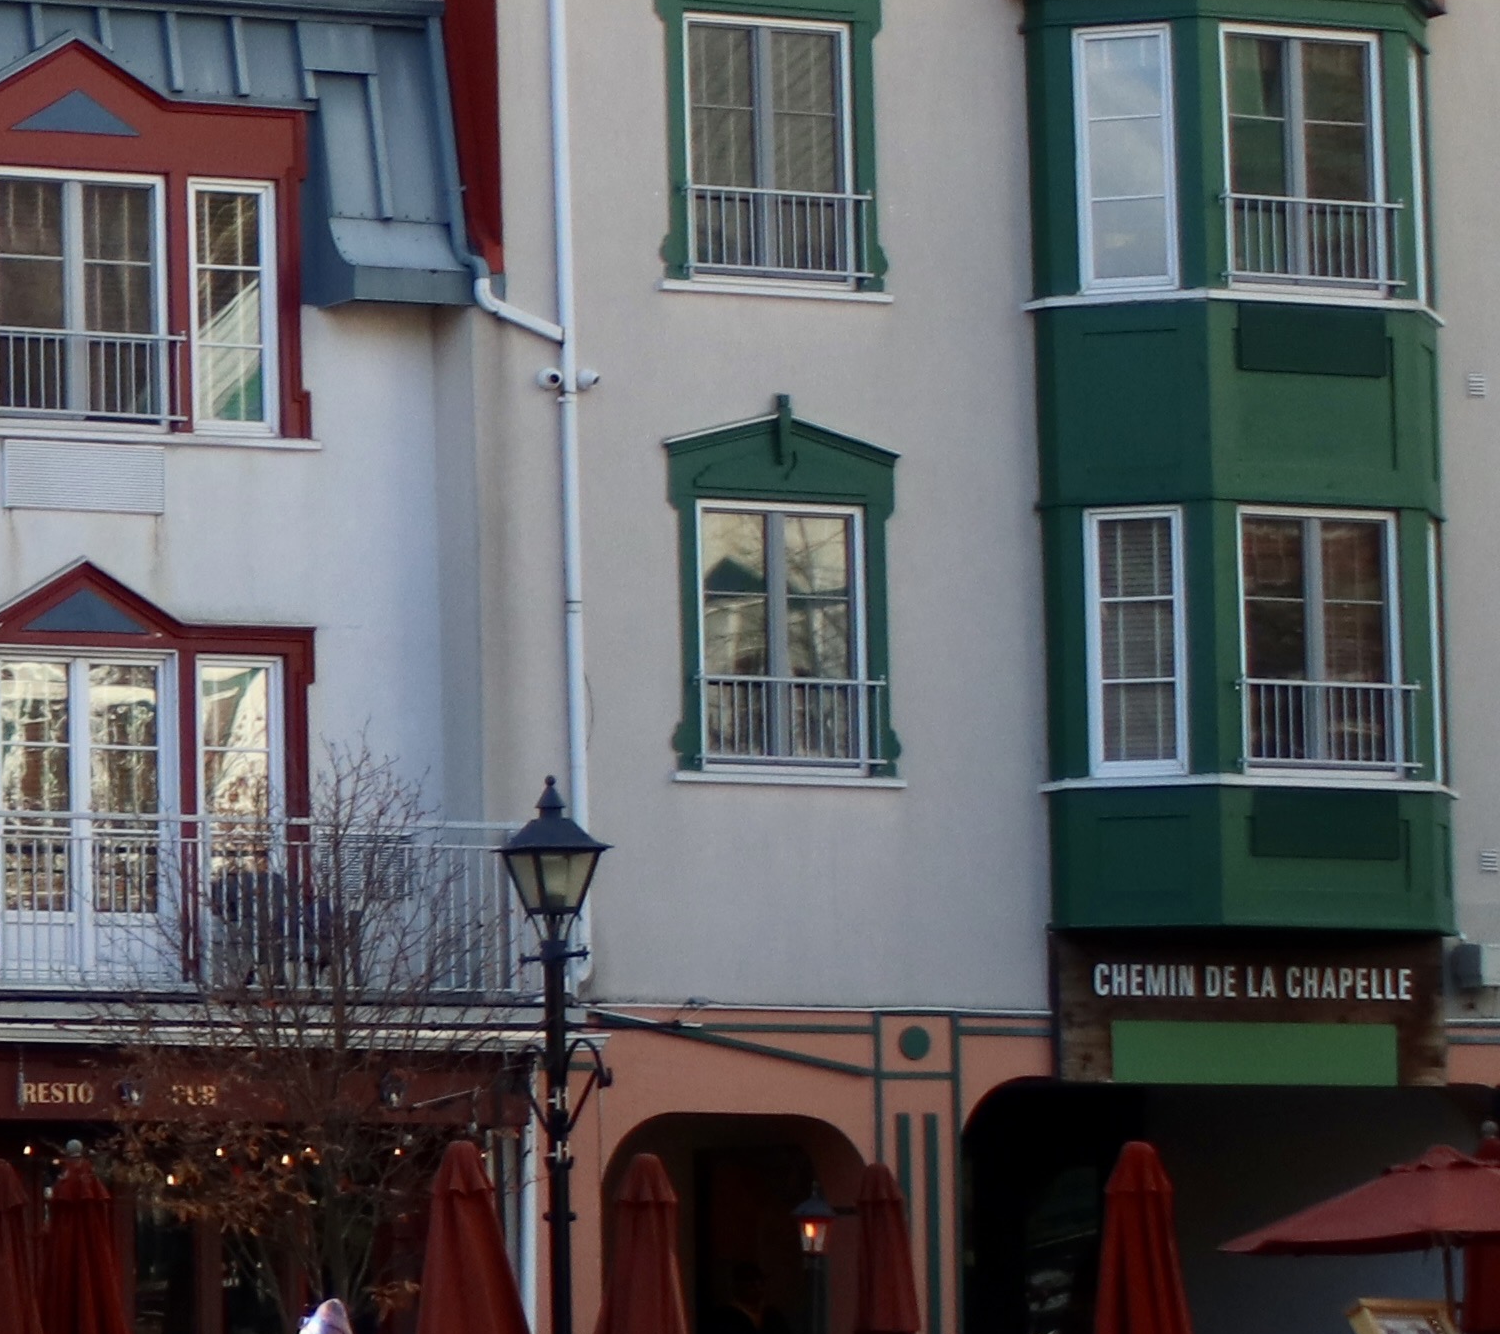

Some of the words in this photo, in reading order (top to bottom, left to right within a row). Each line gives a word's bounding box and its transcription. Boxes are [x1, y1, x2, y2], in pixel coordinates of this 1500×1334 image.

[1093, 963, 1195, 997] CHEMIN
[1205, 965, 1237, 998] DE
[1246, 966, 1277, 999] LA
[1285, 966, 1412, 1000] CHAPELLE
[22, 1082, 94, 1104] RESTO
